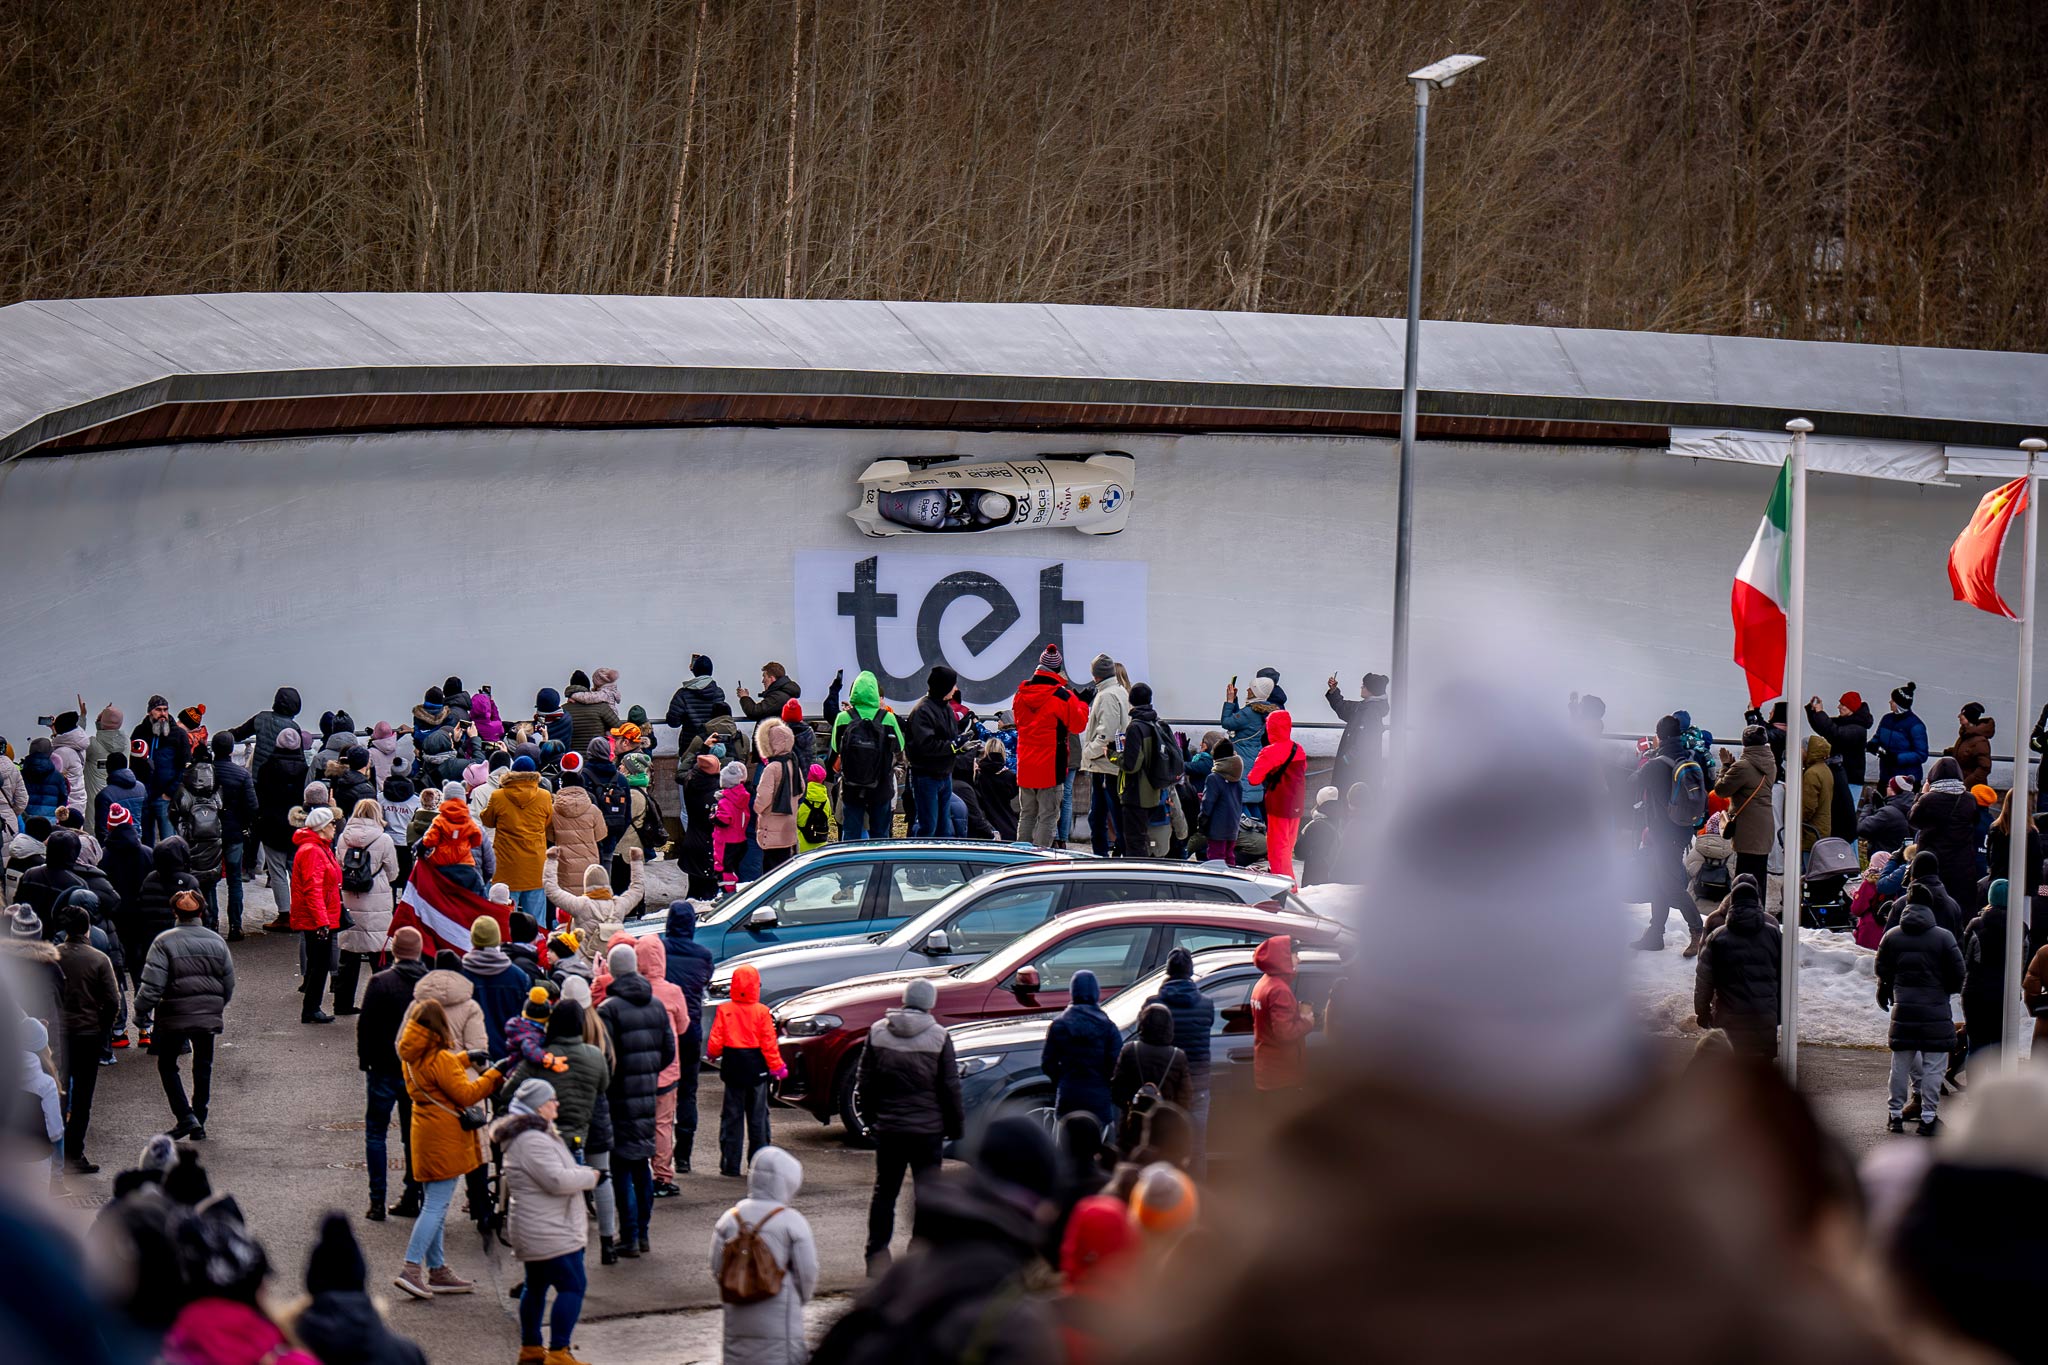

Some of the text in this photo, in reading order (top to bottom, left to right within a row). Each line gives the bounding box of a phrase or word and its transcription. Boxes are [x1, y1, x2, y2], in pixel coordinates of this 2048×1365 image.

[967, 470, 1013, 478] Balcia
[1018, 466, 1043, 475] tet
[866, 489, 875, 504] tet
[1015, 493, 1030, 525] tet
[1032, 489, 1046, 523] Balcia
[1060, 487, 1072, 521] LATVIJA
[931, 501, 940, 519] tet
[838, 555, 1095, 704] tet
